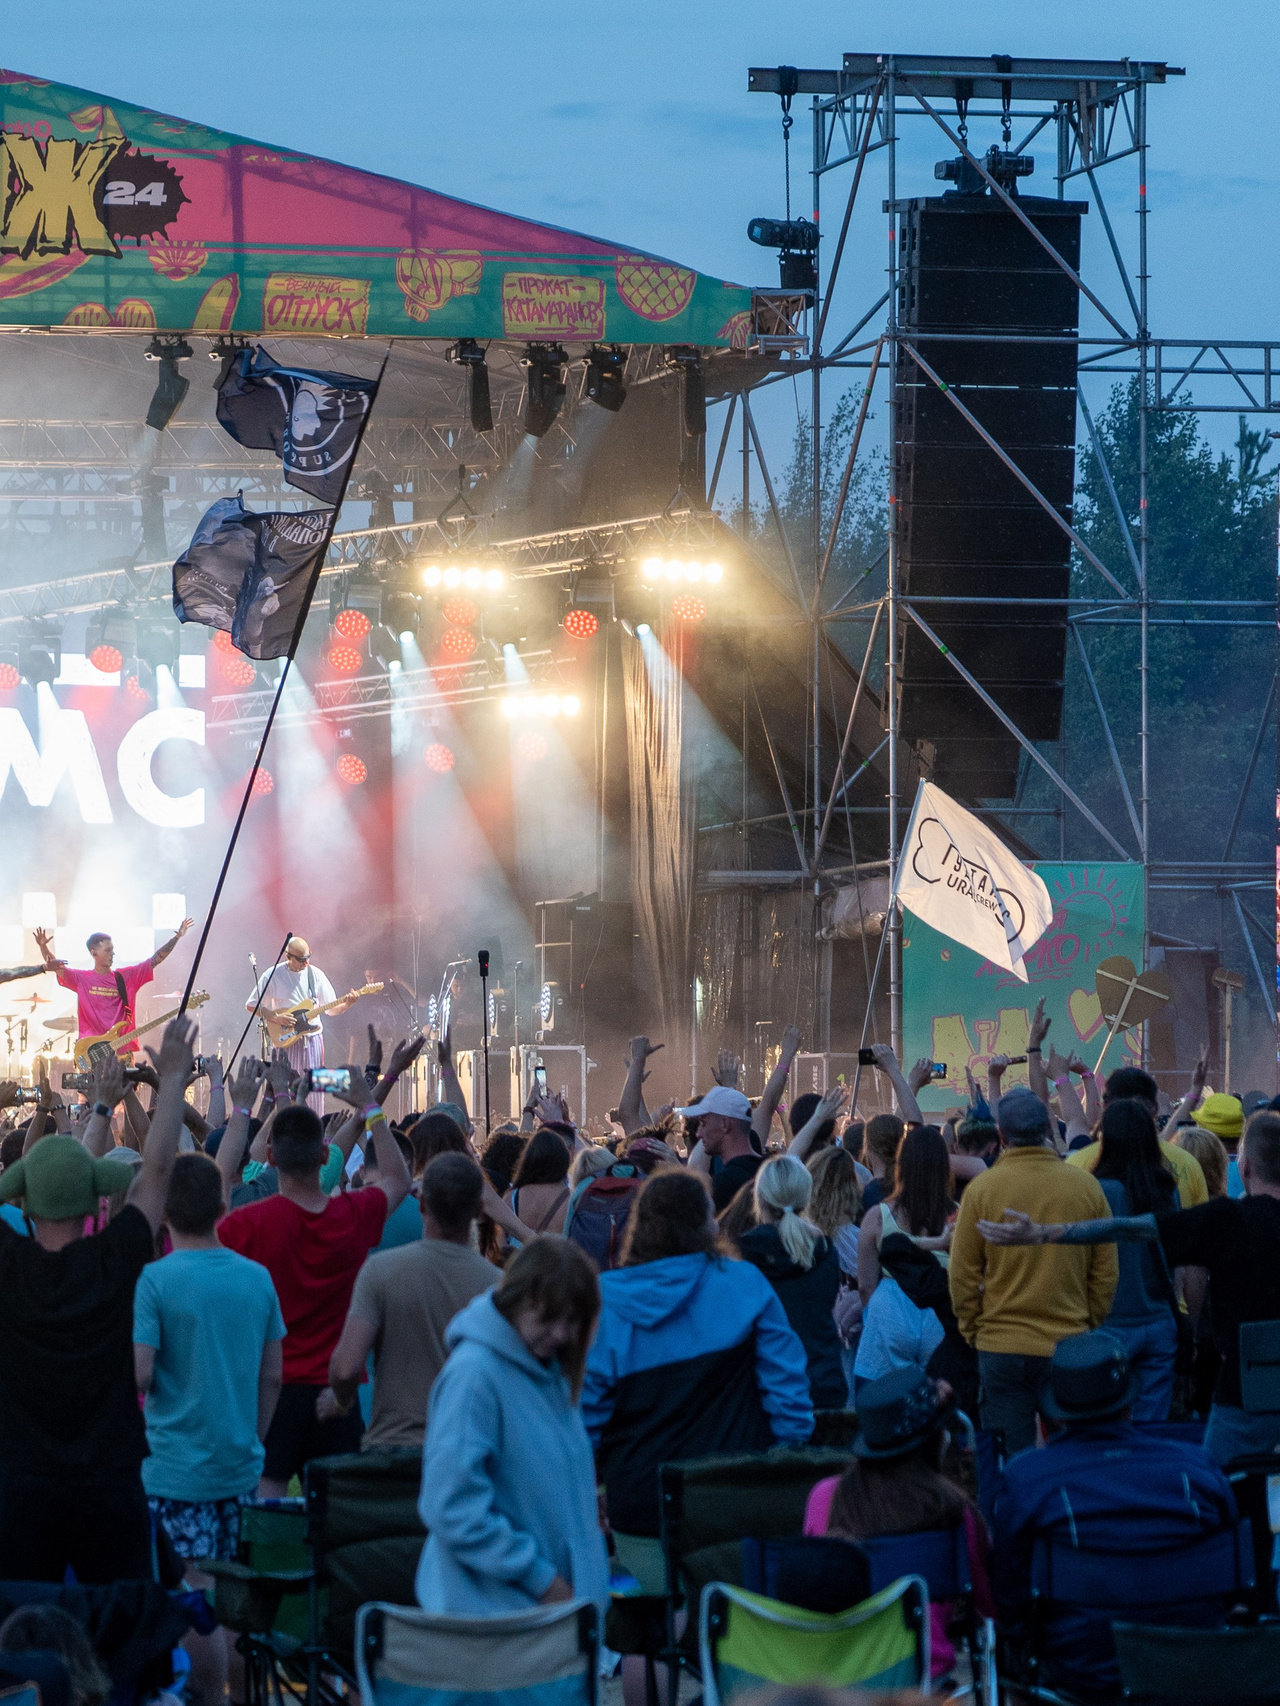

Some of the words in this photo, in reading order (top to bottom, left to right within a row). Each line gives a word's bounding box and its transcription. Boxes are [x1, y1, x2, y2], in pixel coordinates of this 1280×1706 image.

[285, 278, 341, 293] ВЕЧНЫЙ
[517, 277, 574, 296] ПРОКАТ
[267, 293, 365, 331] ОТПУСК
[505, 294, 599, 325] КАТАМАРАНОВ
